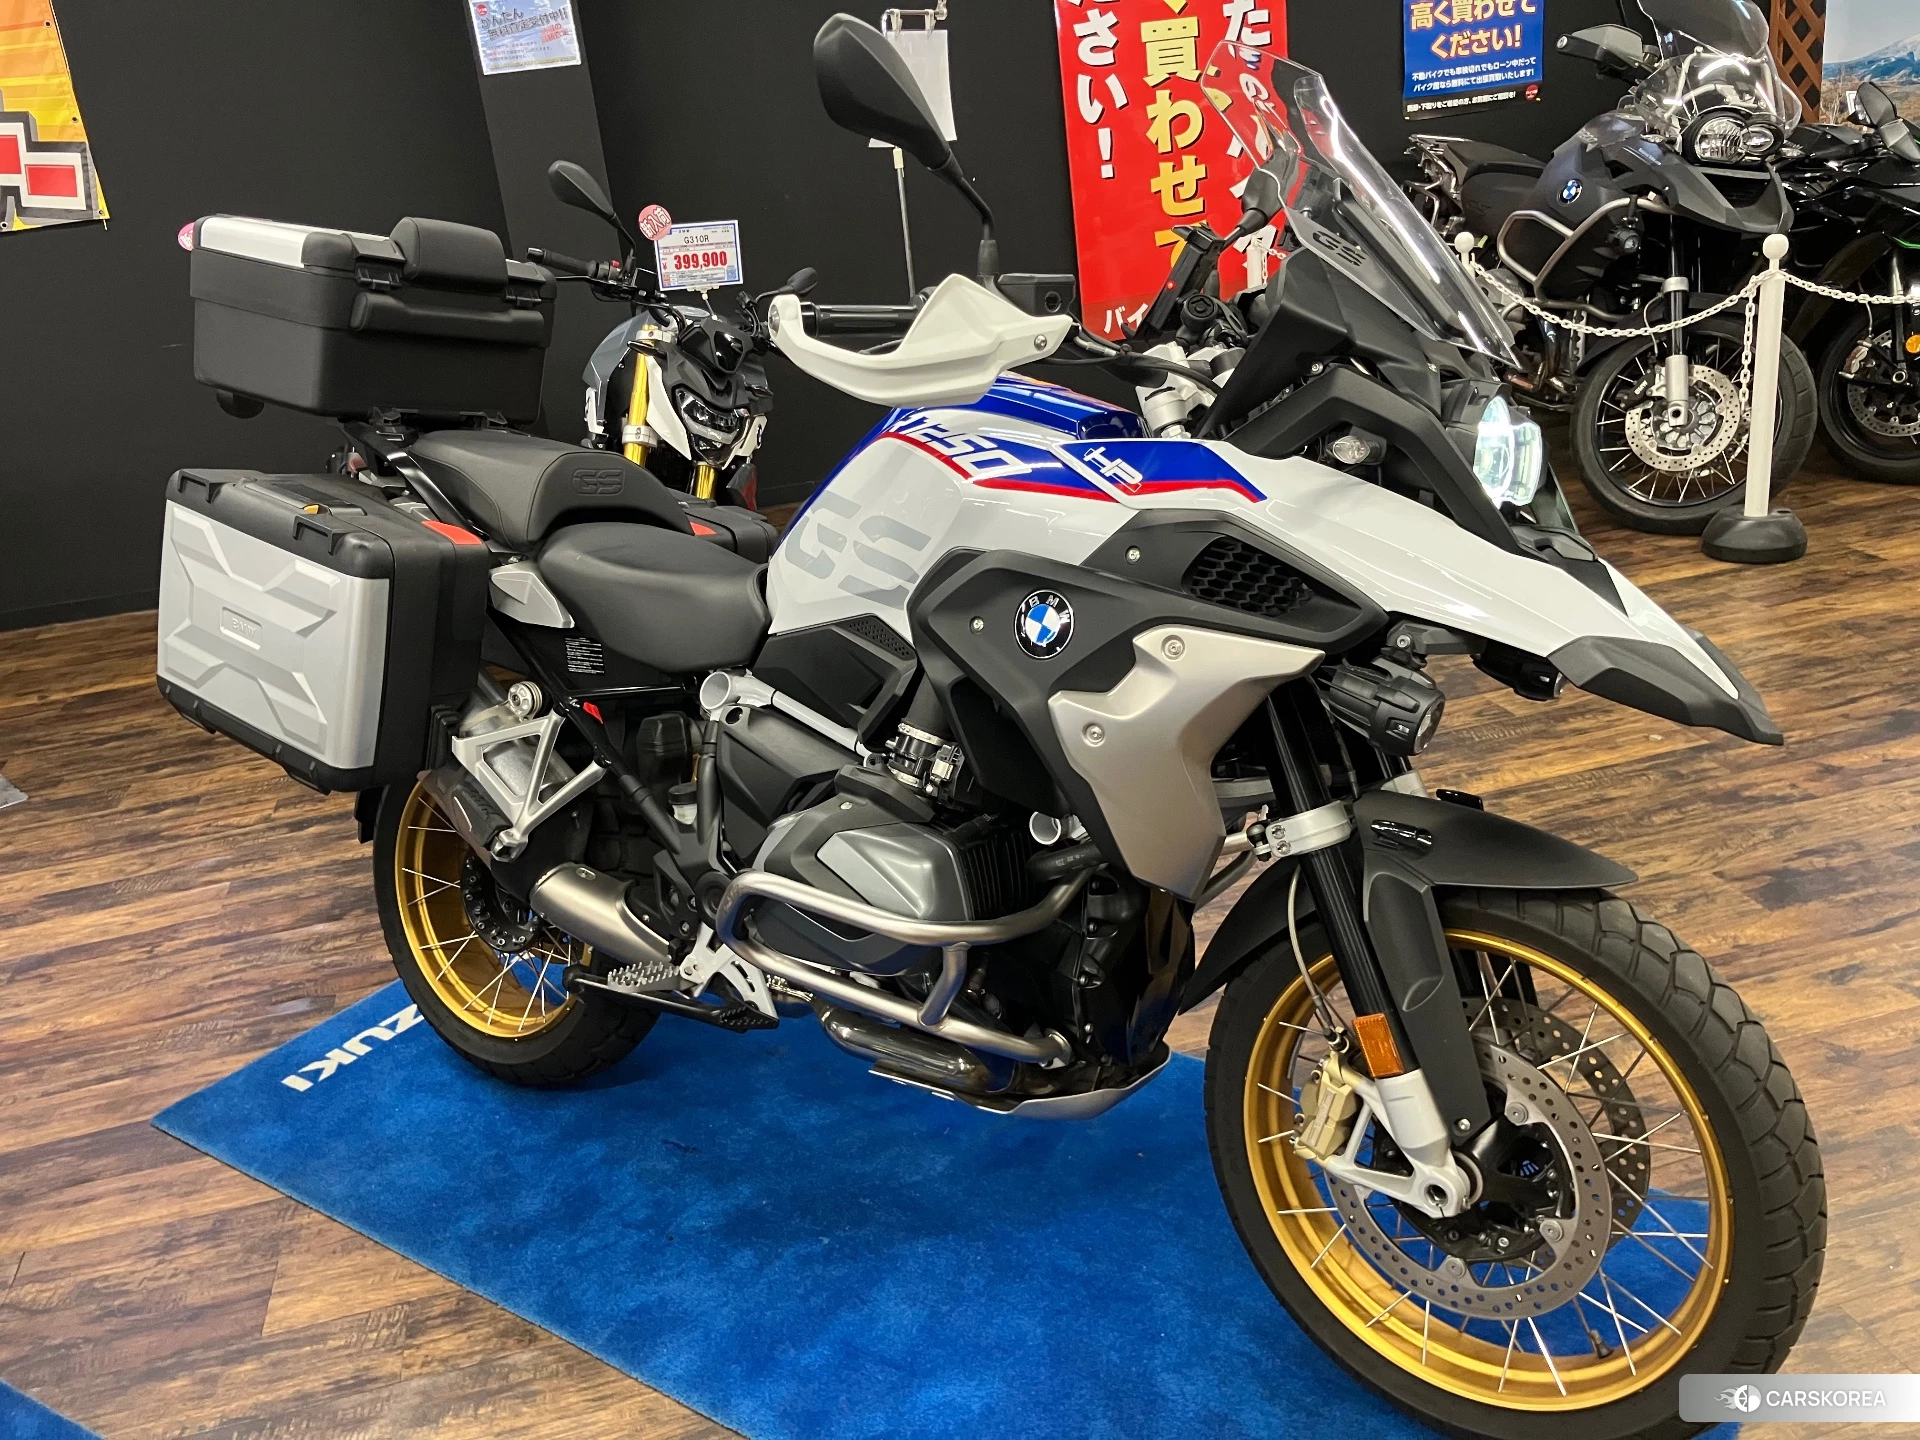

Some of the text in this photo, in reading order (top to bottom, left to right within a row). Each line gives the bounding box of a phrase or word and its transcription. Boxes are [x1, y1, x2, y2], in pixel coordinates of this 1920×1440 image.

[1431, 25, 1522, 58] ください!
[1073, 0, 1128, 179] さい!
[639, 206, 671, 239] 新入荷
[683, 234, 710, 245] G310R
[1312, 230, 1367, 267] GS
[673, 250, 728, 271] 399,900
[573, 469, 625, 496] GS
[1082, 446, 1144, 486] HP
[1028, 594, 1071, 625] BMW
[281, 1003, 425, 1092] ZUKI
